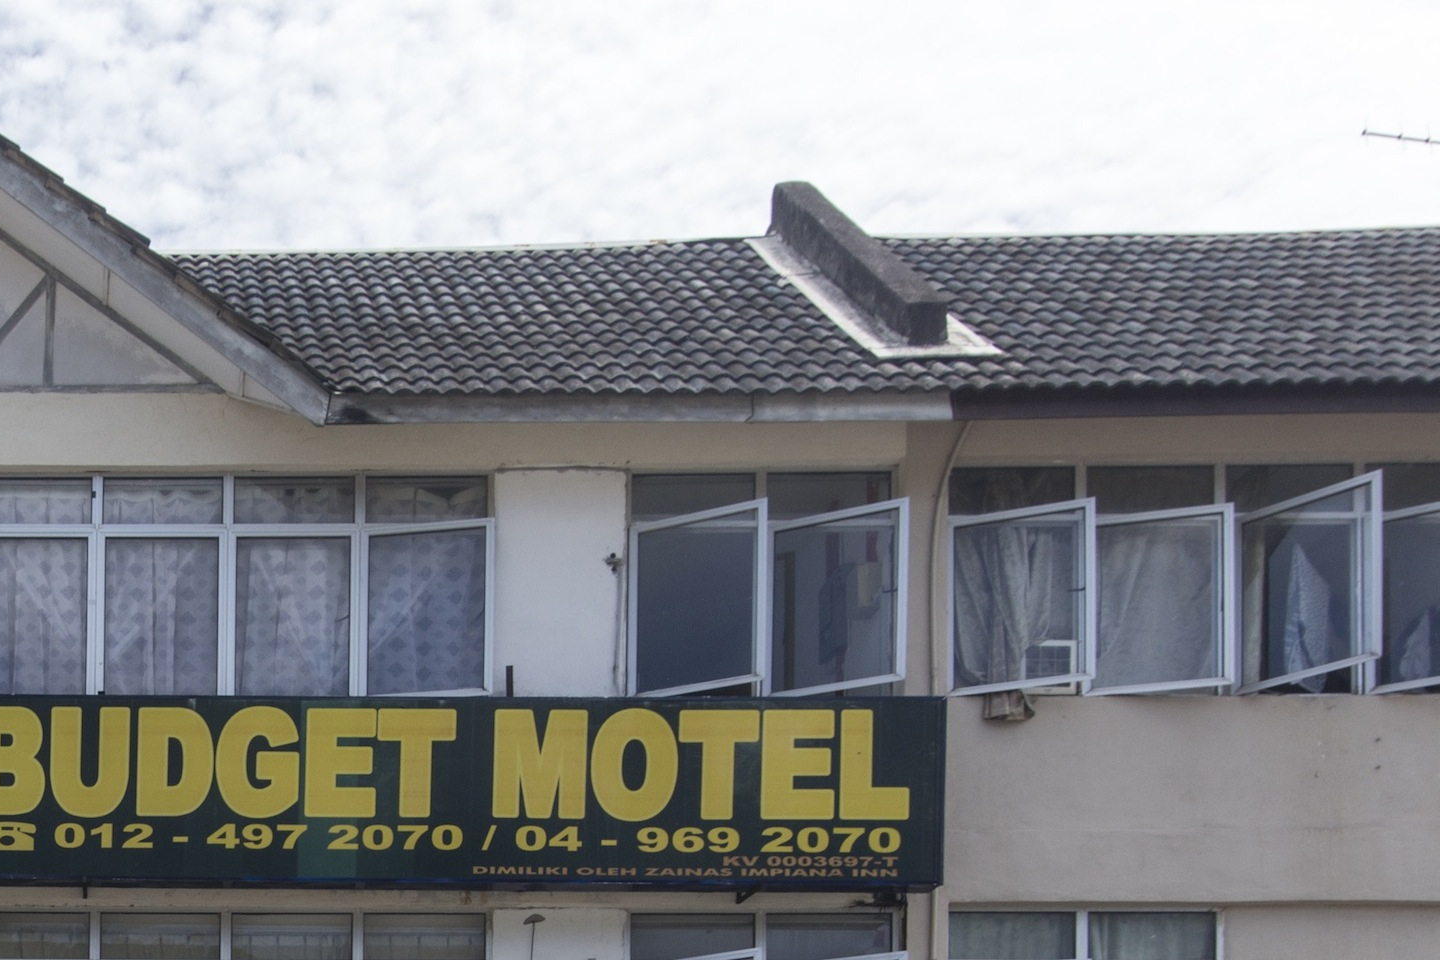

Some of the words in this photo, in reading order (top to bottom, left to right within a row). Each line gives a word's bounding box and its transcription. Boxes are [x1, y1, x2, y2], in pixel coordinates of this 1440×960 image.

[492, 708, 910, 822] MOTEL
[54, 823, 154, 849] 012
[206, 824, 308, 850] 497
[328, 824, 464, 851] 2070
[514, 825, 583, 852] 04
[636, 826, 740, 852] 969
[760, 827, 901, 854] 2070
[473, 866, 568, 875] DIMILIKI
[576, 867, 637, 876] OLEH
[645, 868, 732, 876] ZAINAS
[741, 868, 844, 877] IMPIANA
[852, 868, 898, 877] INN
[722, 856, 759, 866] KV
[767, 856, 898, 867] 0003697-T
